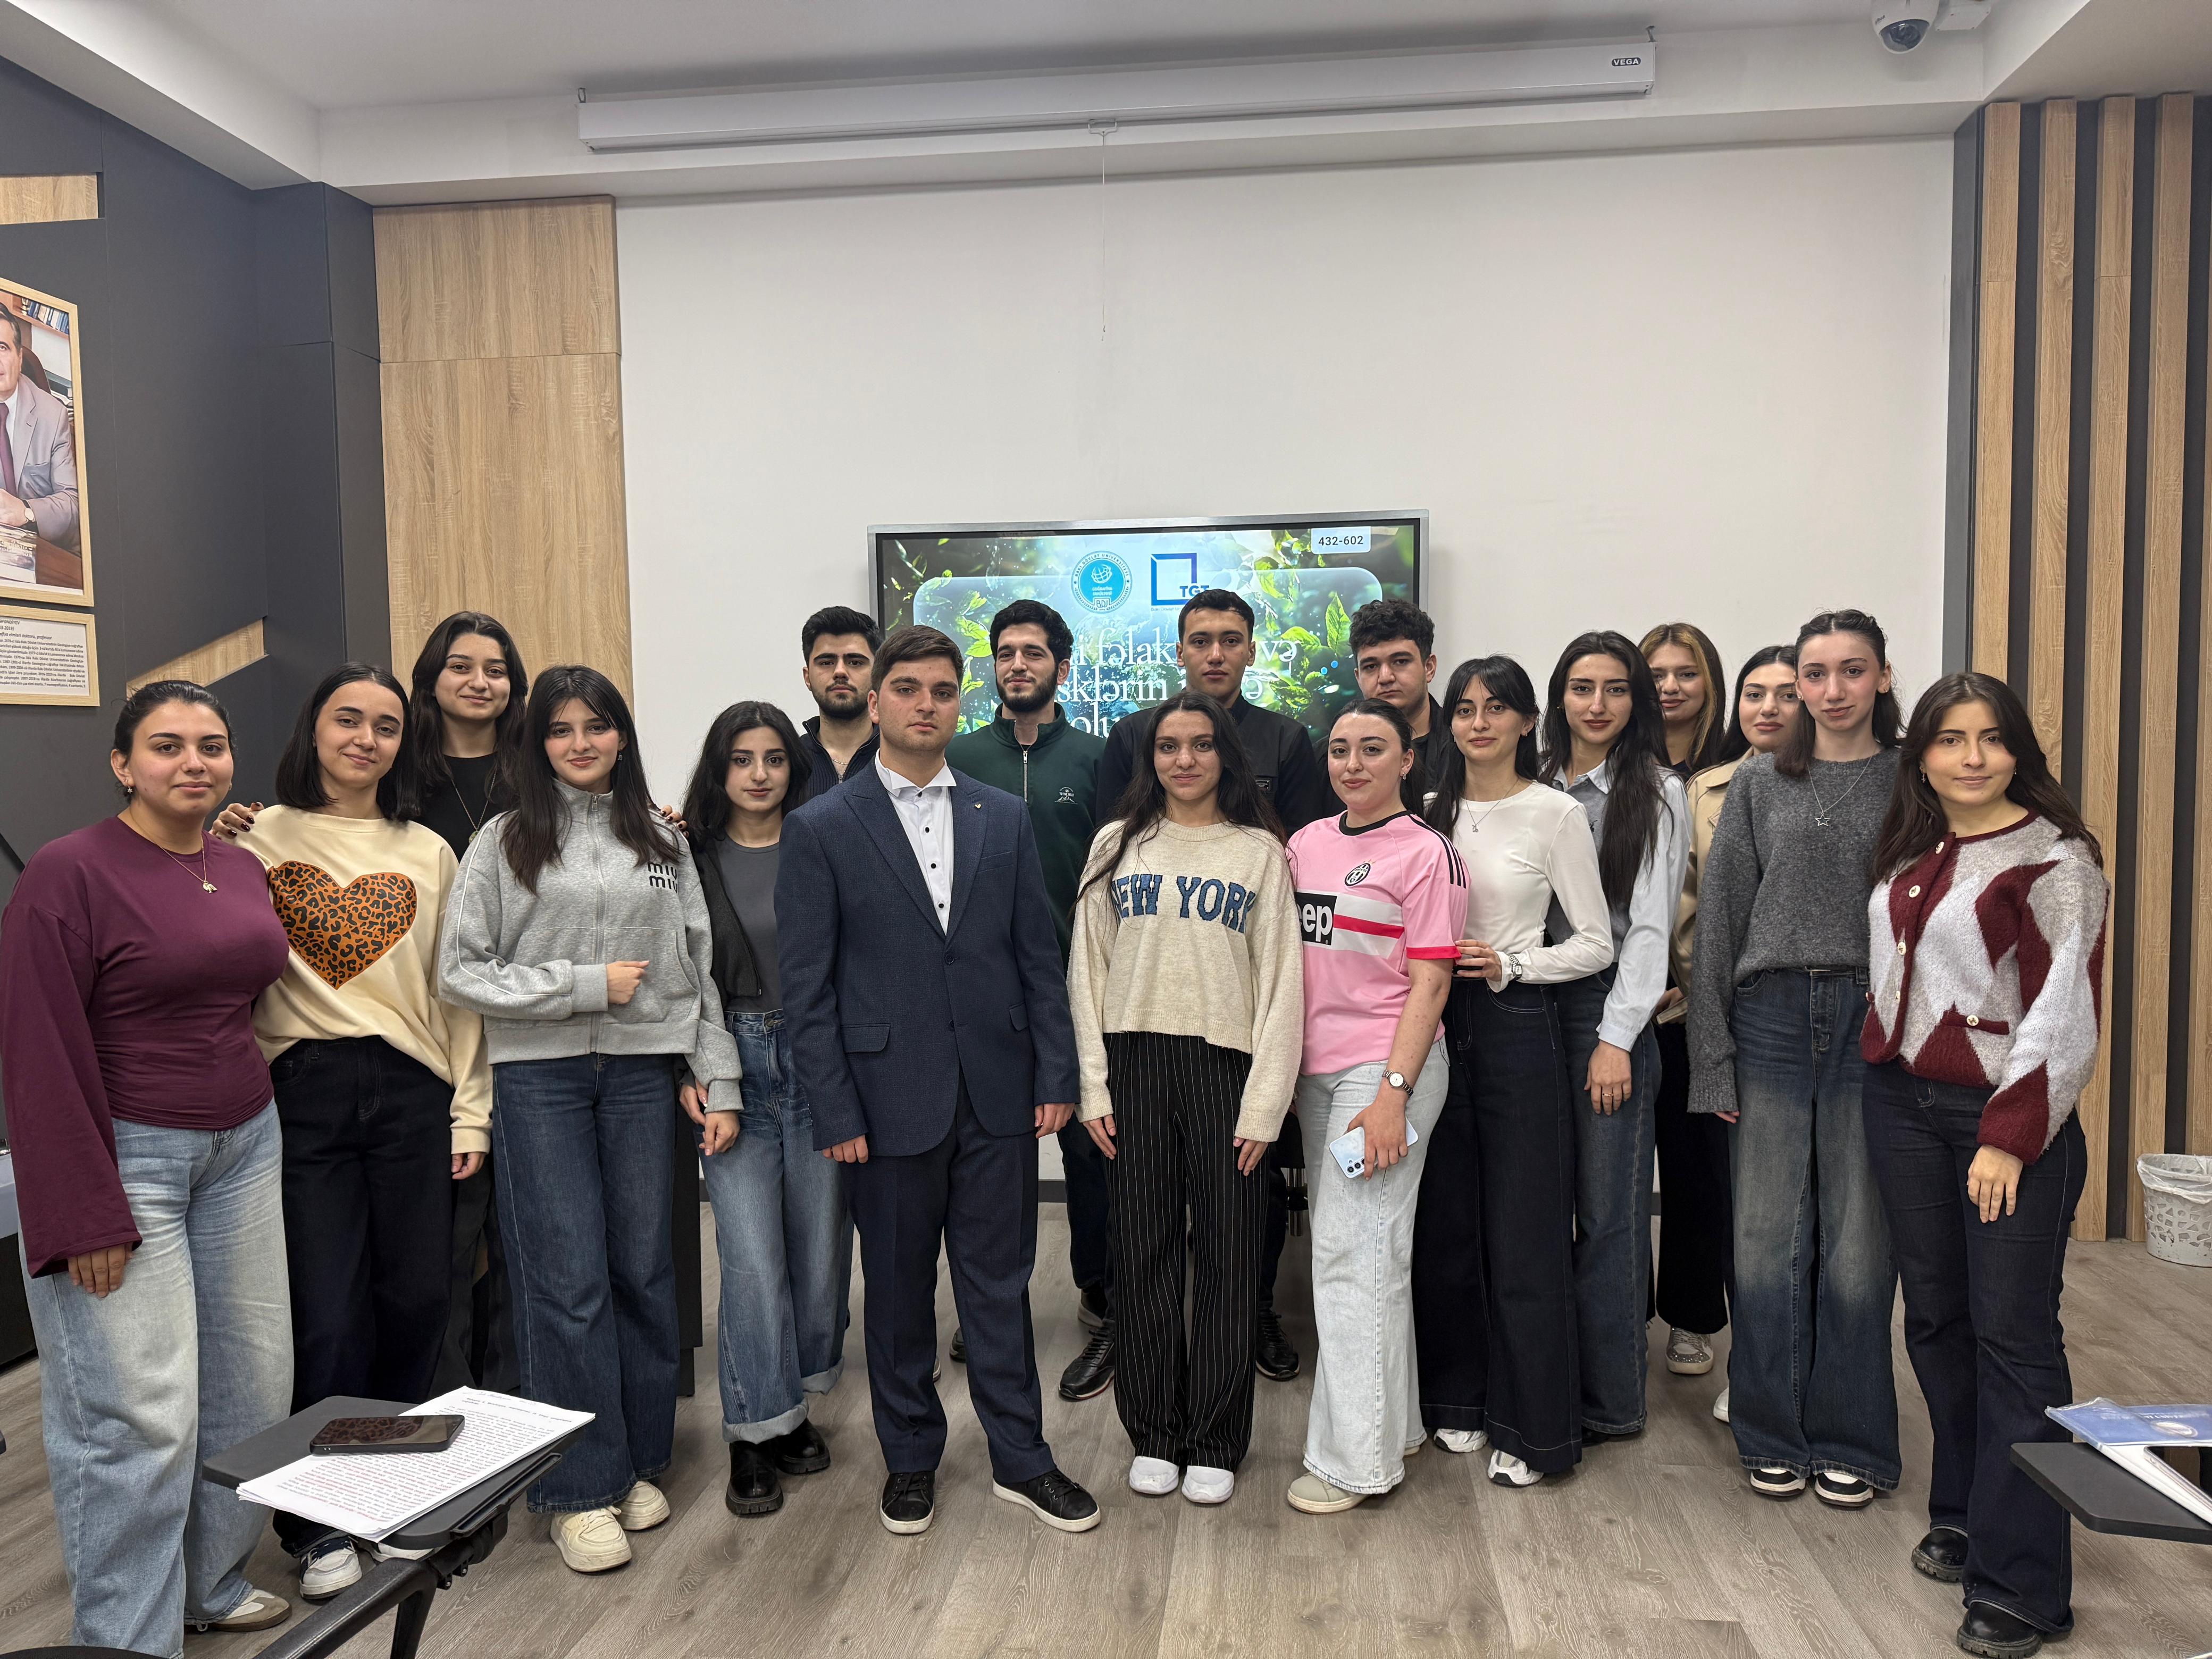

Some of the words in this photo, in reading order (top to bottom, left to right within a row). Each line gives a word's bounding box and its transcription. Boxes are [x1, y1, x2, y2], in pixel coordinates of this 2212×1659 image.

[1319, 536, 1363, 546] 432-602
[1096, 626, 1177, 665] fəlak
[1259, 639, 1297, 662] və
[1055, 665, 1168, 702] sklərin
[647, 862, 677, 880] miu
[1297, 903, 1333, 942] ep
